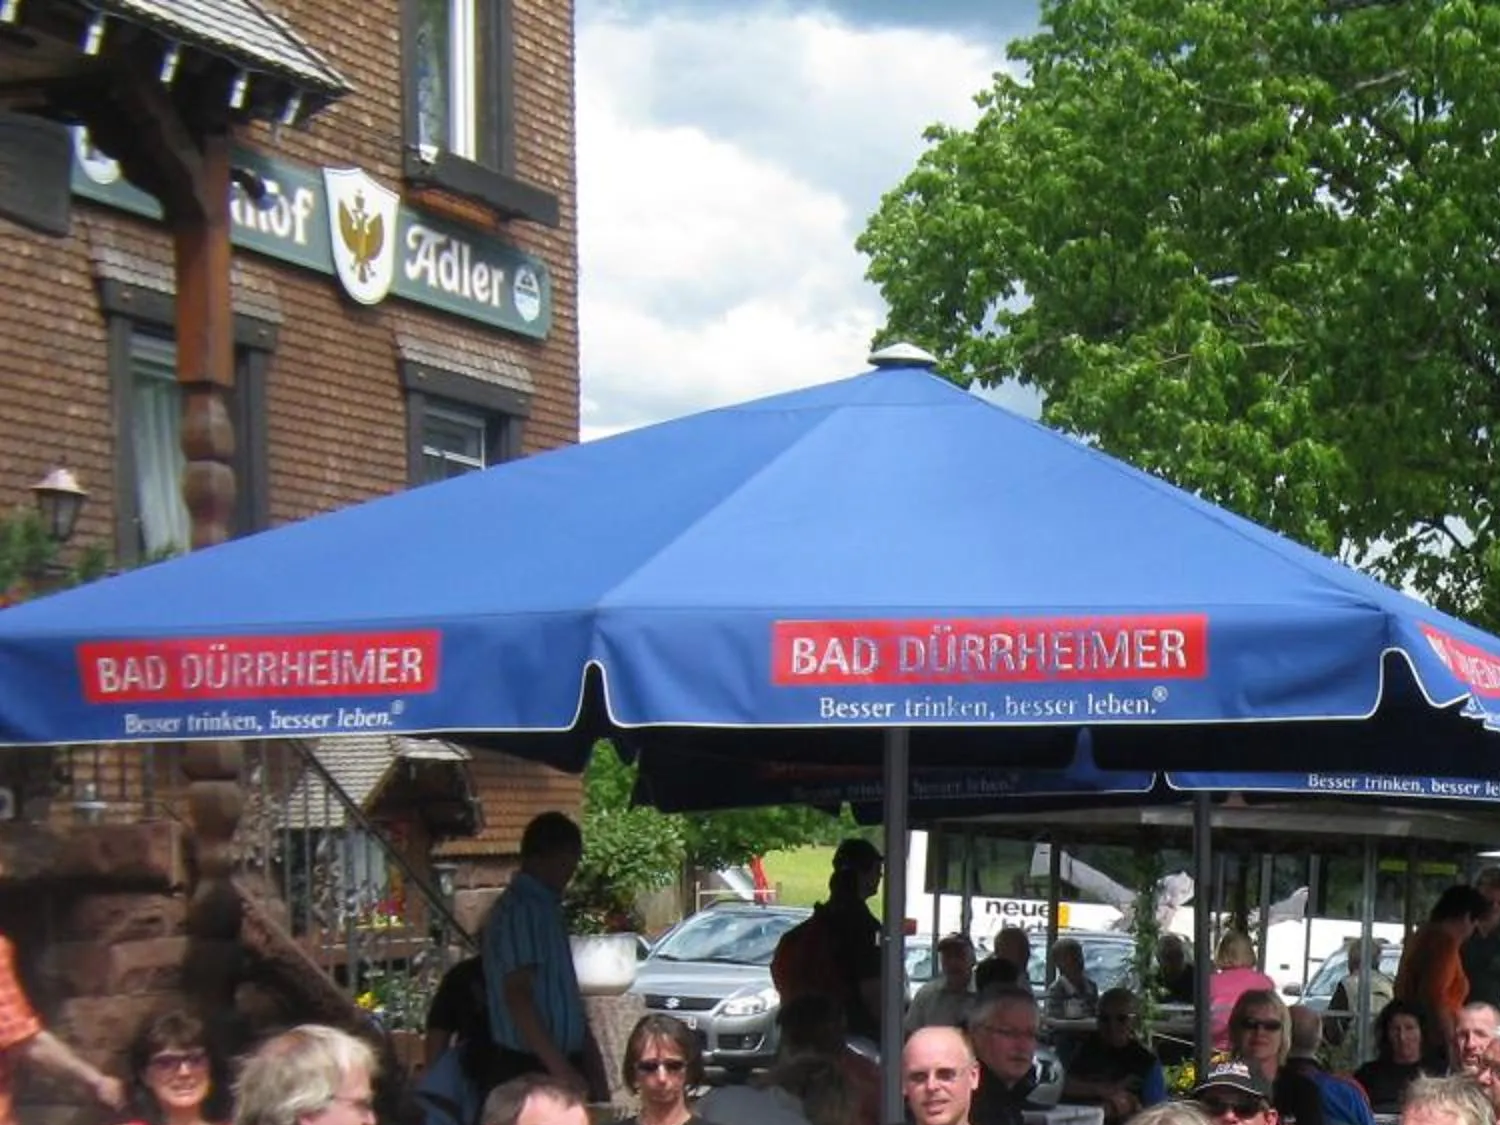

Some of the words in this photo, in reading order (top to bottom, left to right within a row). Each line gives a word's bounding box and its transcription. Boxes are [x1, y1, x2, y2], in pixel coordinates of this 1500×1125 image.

[404, 225, 504, 307] Adler
[97, 655, 167, 693] BAD
[181, 644, 423, 690] DÜRRHEIMER
[791, 636, 879, 675] BAD
[898, 625, 1187, 673] DÜRRHEIMER
[124, 713, 181, 734] Besser
[187, 711, 263, 733] trinken,
[270, 709, 329, 730] besser
[820, 696, 895, 719] Besser
[904, 696, 996, 721] trinken,
[1005, 694, 1077, 717] besser
[1308, 773, 1357, 789] Besser
[1365, 776, 1425, 793] trinken,
[1431, 778, 1480, 795] besser
